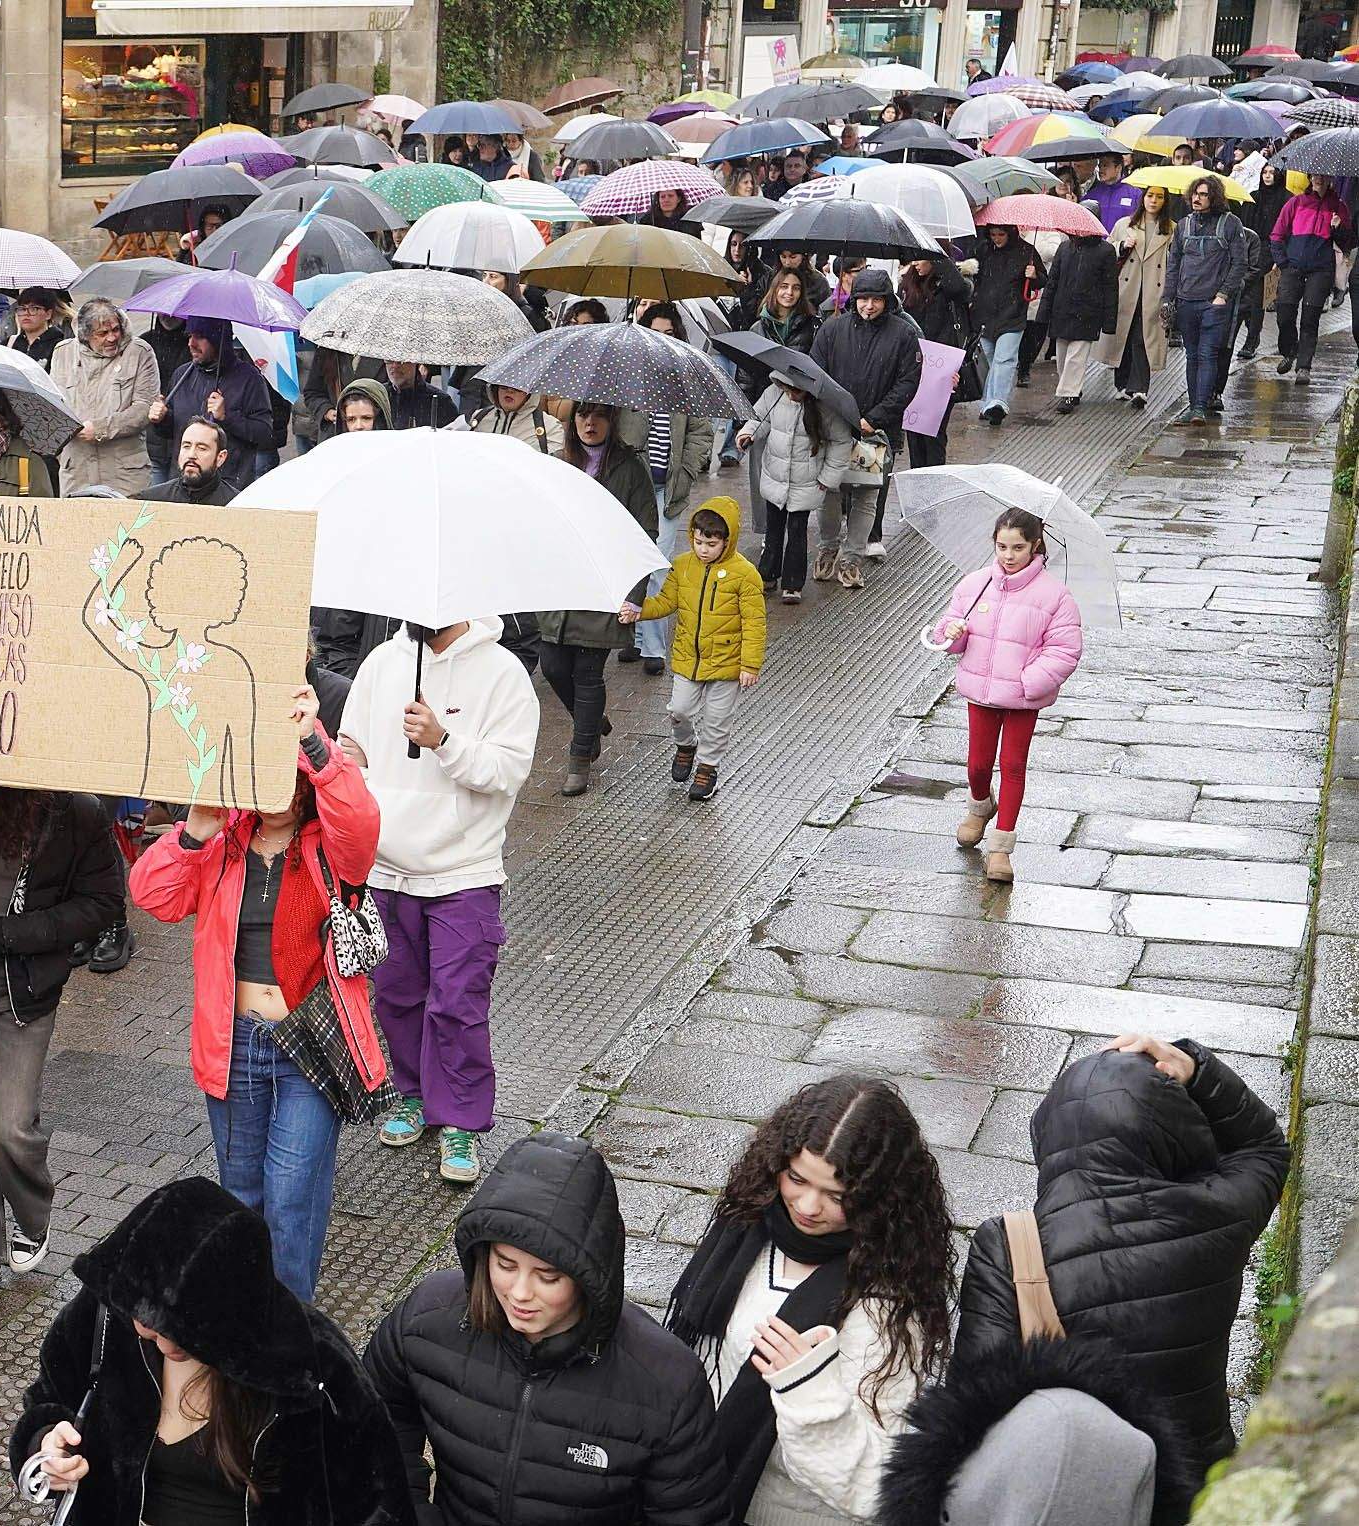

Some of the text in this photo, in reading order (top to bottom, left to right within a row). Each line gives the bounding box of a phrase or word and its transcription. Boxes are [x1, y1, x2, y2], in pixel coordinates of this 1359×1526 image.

[567, 1446, 596, 1459] NORTH
[580, 1442, 597, 1454] THE
[573, 1455, 595, 1467] FACE
